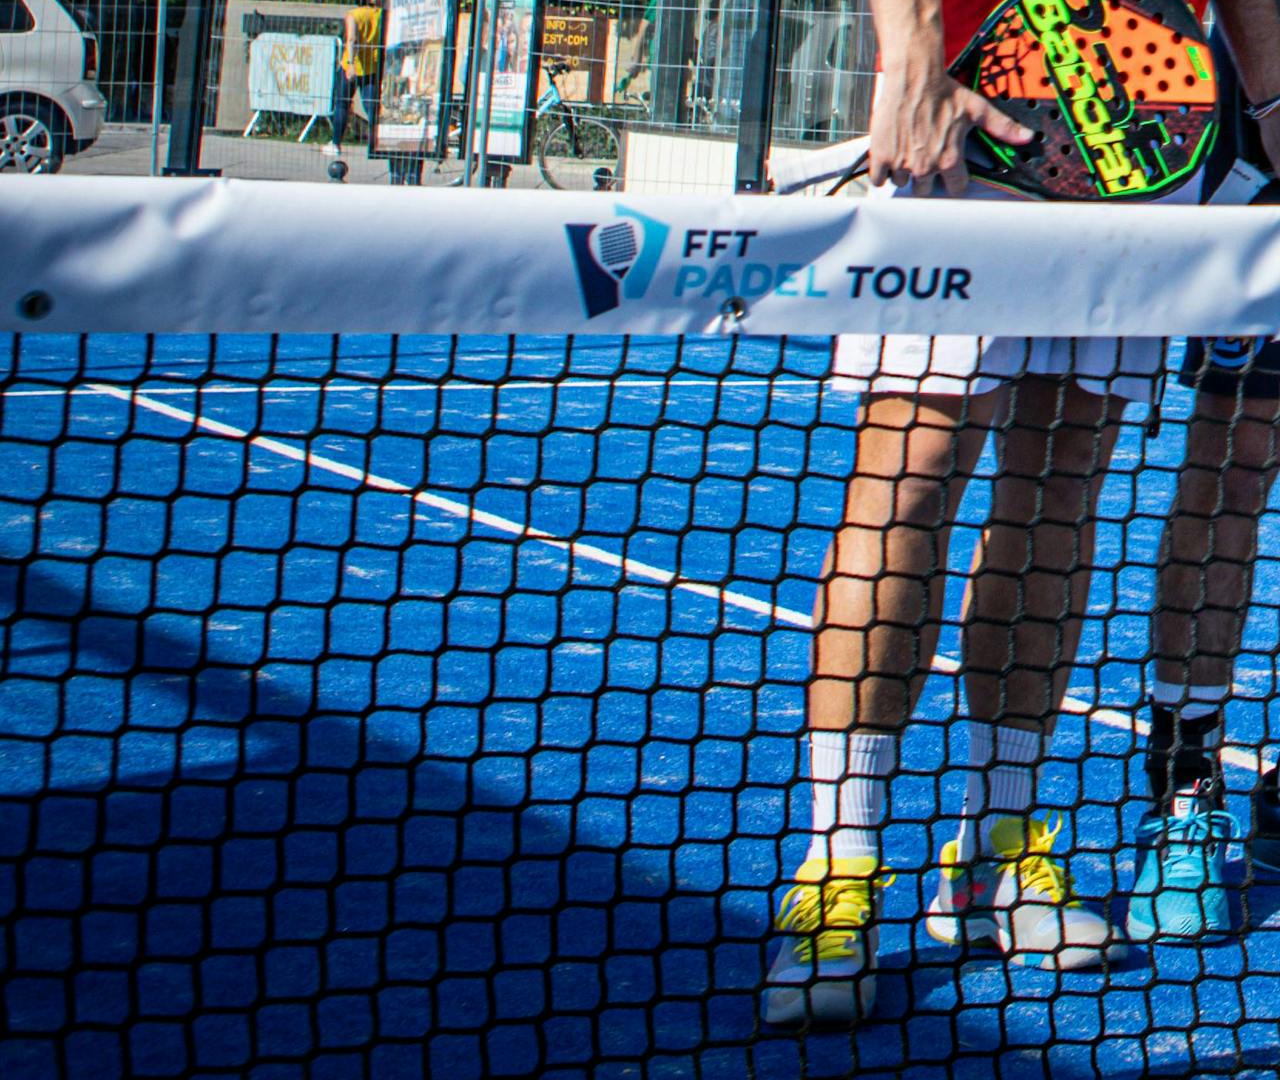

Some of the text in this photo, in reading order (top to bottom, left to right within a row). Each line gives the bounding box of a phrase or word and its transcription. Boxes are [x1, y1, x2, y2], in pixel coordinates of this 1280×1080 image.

[683, 229, 758, 258] FFT
[674, 263, 971, 300] PADEL TOUR
